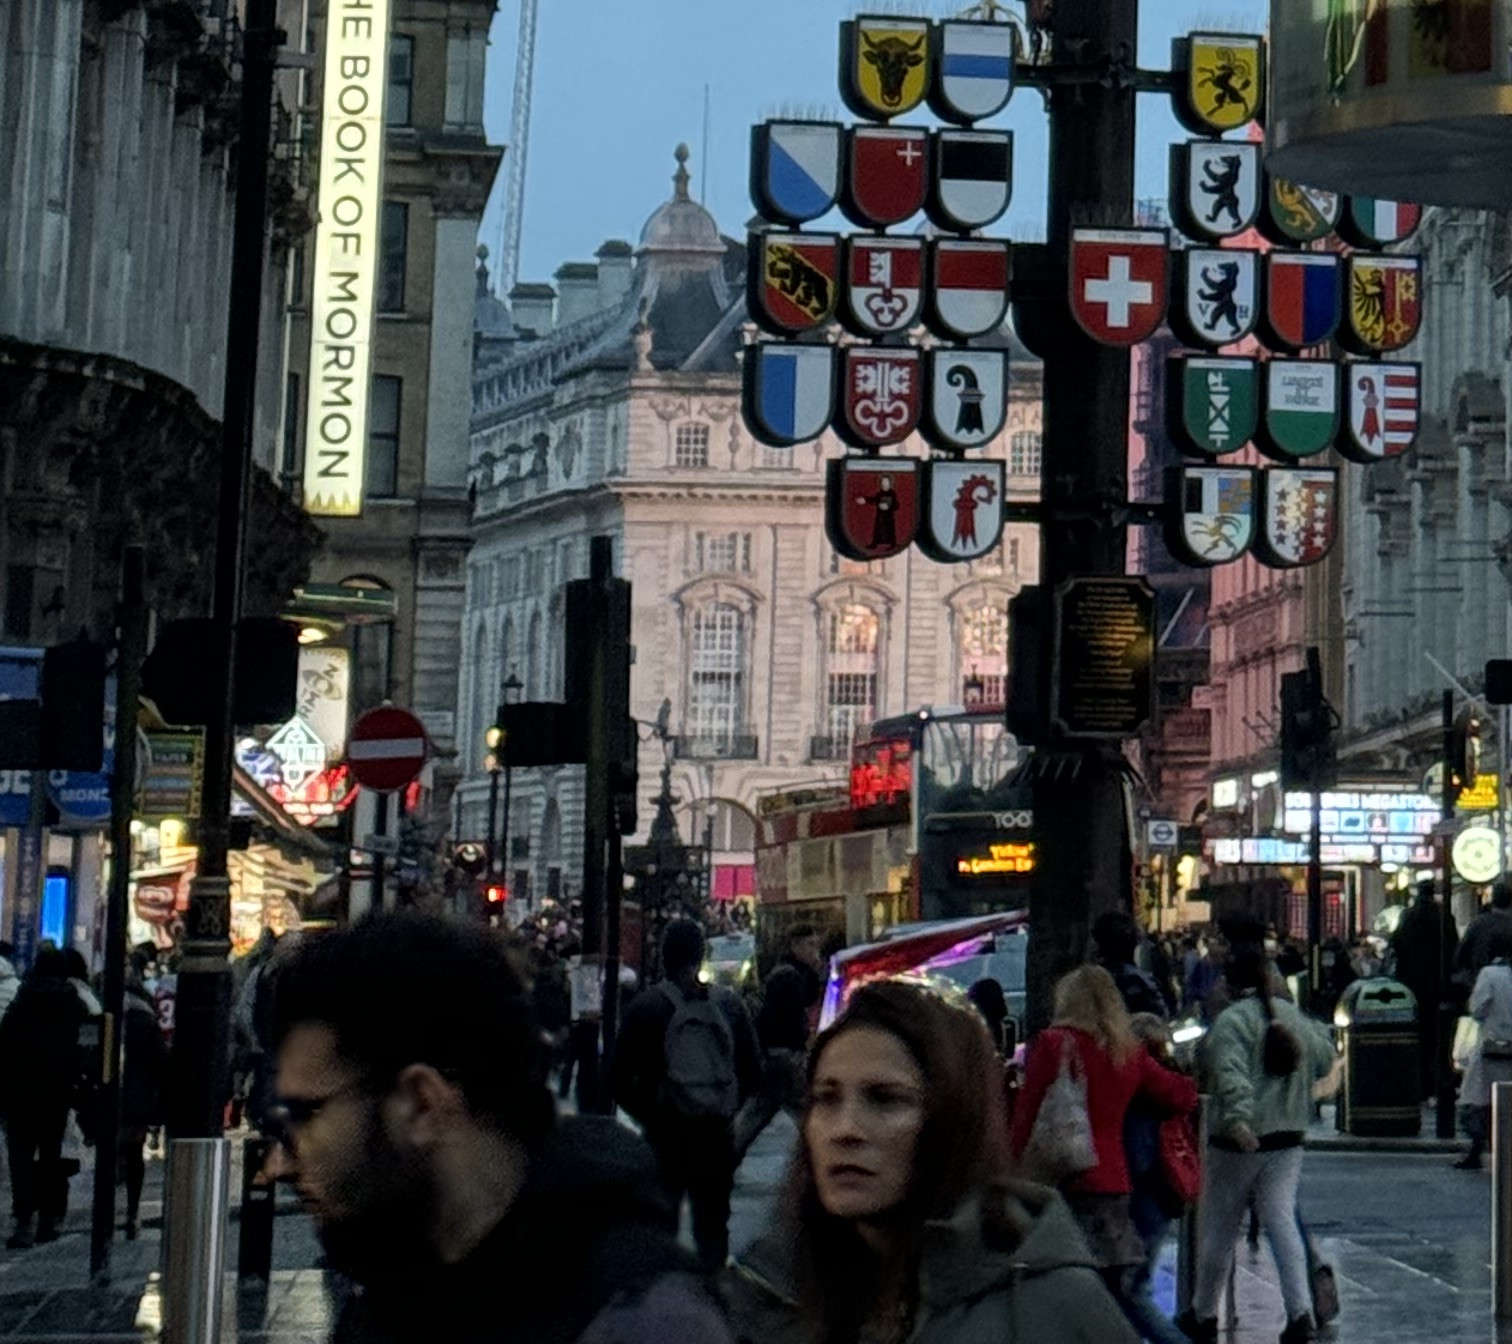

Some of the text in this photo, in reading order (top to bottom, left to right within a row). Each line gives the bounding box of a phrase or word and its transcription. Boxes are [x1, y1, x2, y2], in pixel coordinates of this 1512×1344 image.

[332, 55, 371, 185] BOOK
[330, 194, 364, 256] OF
[317, 270, 359, 479] MORMON
[992, 811, 1034, 828] TOO
